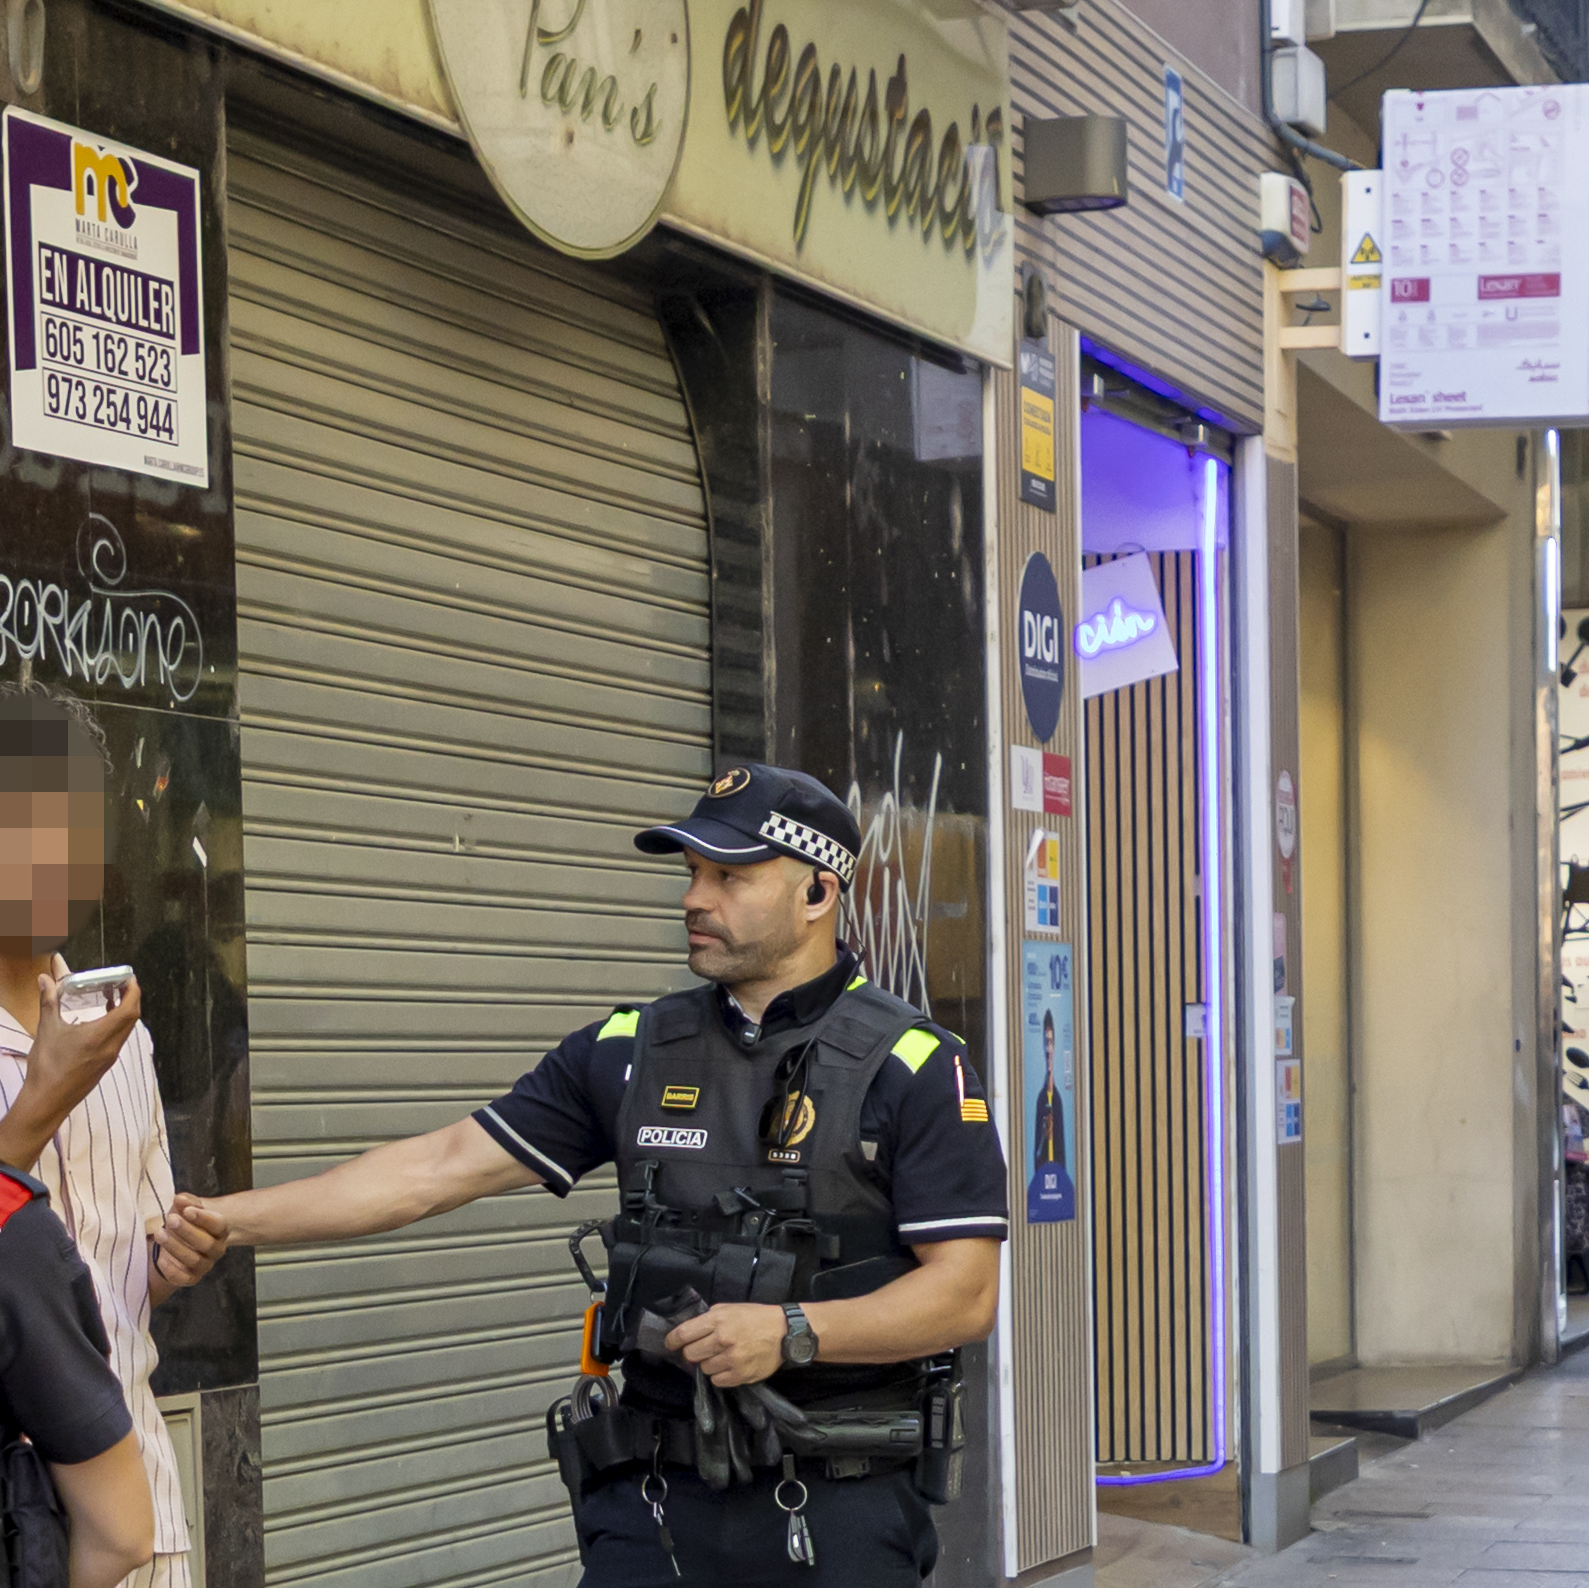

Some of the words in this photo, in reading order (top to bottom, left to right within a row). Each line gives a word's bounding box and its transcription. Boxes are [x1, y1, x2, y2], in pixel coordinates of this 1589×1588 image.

[75, 218, 101, 239] MARTA
[40, 247, 69, 306] EN
[75, 257, 175, 336] ALQUILER
[44, 317, 85, 365] 605
[92, 330, 129, 377] 162
[135, 346, 172, 388] 523
[47, 372, 87, 420] 973
[93, 385, 131, 431] 254
[137, 395, 174, 441] 944
[1023, 610, 1059, 664] DIGI
[640, 1129, 703, 1147] POLICIA
